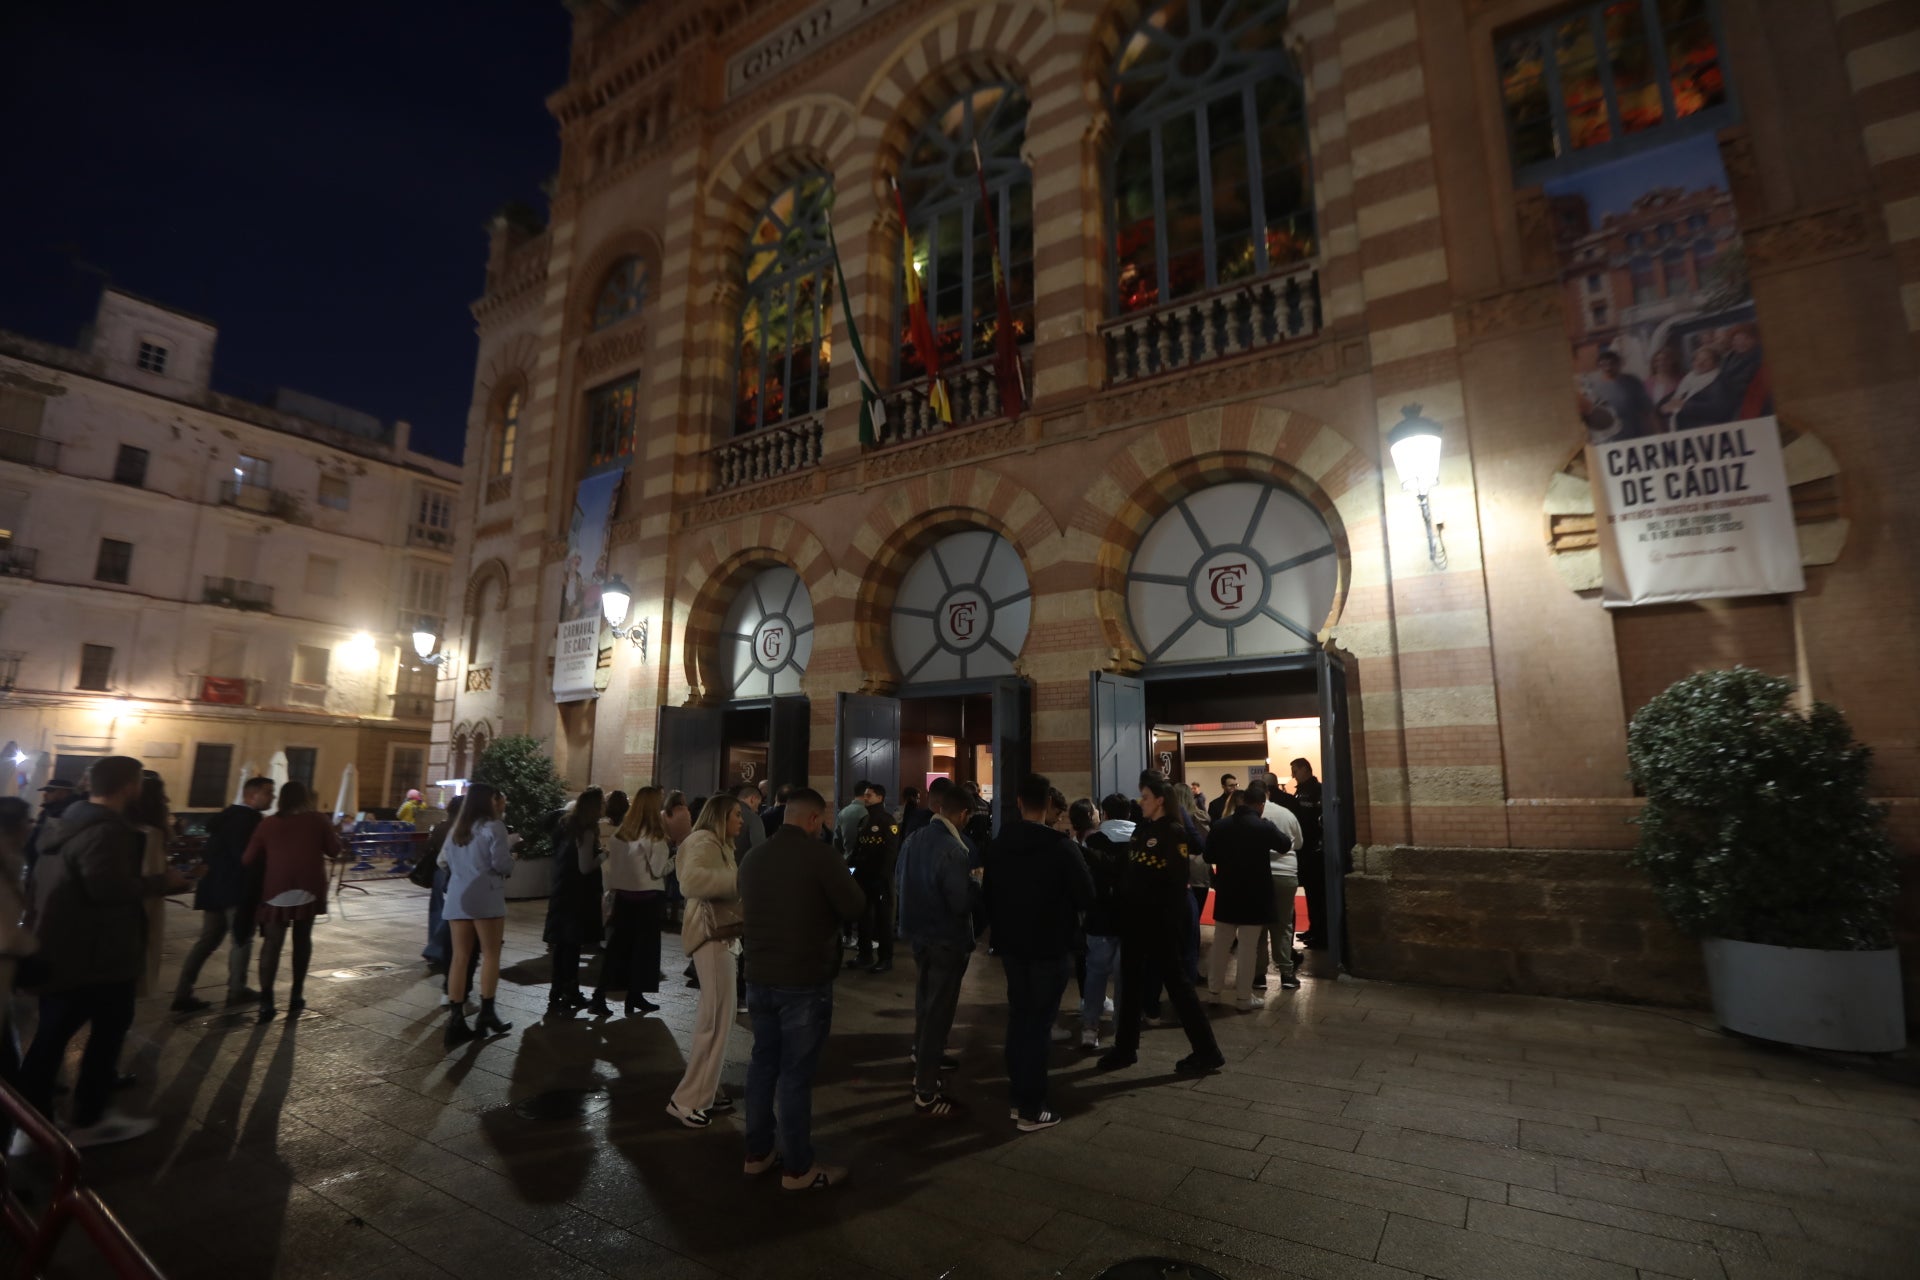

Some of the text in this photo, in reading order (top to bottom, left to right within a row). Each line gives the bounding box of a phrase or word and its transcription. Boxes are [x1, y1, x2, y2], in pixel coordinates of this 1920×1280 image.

[1607, 429, 1755, 476] CARNAVAL
[1621, 462, 1750, 507] DE CÁDIZ
[563, 621, 595, 639] CARNAVAL
